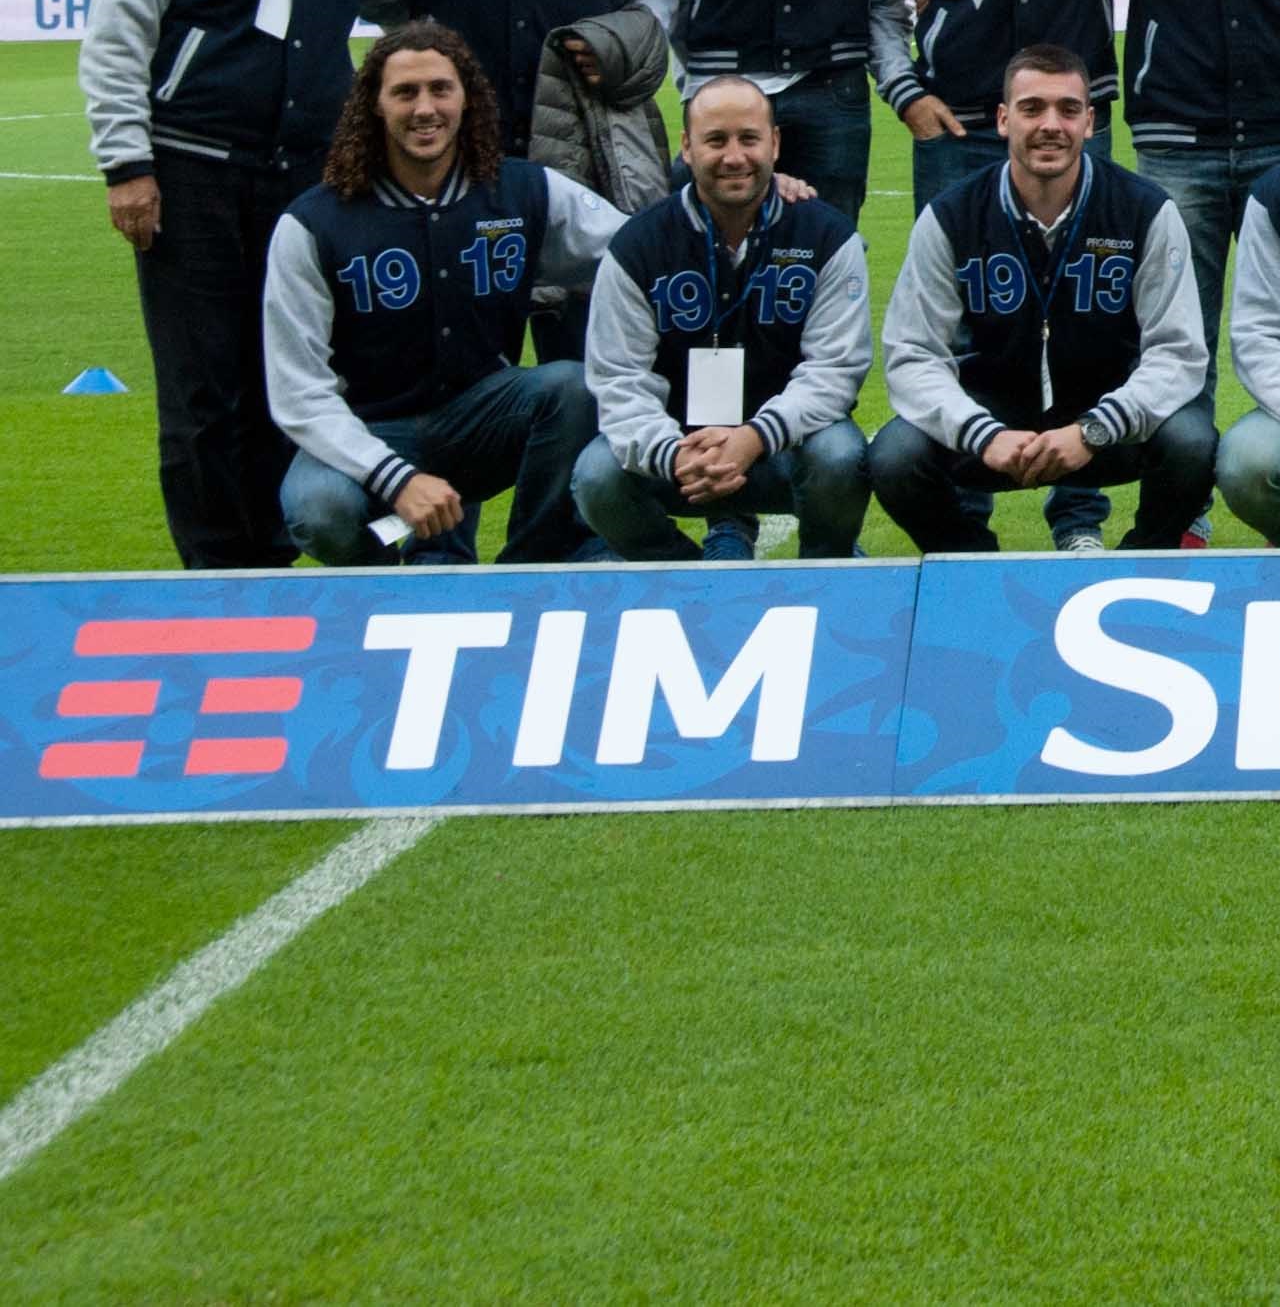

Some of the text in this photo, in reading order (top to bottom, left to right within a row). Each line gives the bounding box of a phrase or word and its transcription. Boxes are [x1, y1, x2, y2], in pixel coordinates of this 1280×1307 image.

[338, 232, 527, 313] 19 13
[649, 264, 818, 333] 19 13
[957, 253, 1134, 315] 19 13
[362, 606, 818, 770] TIM
